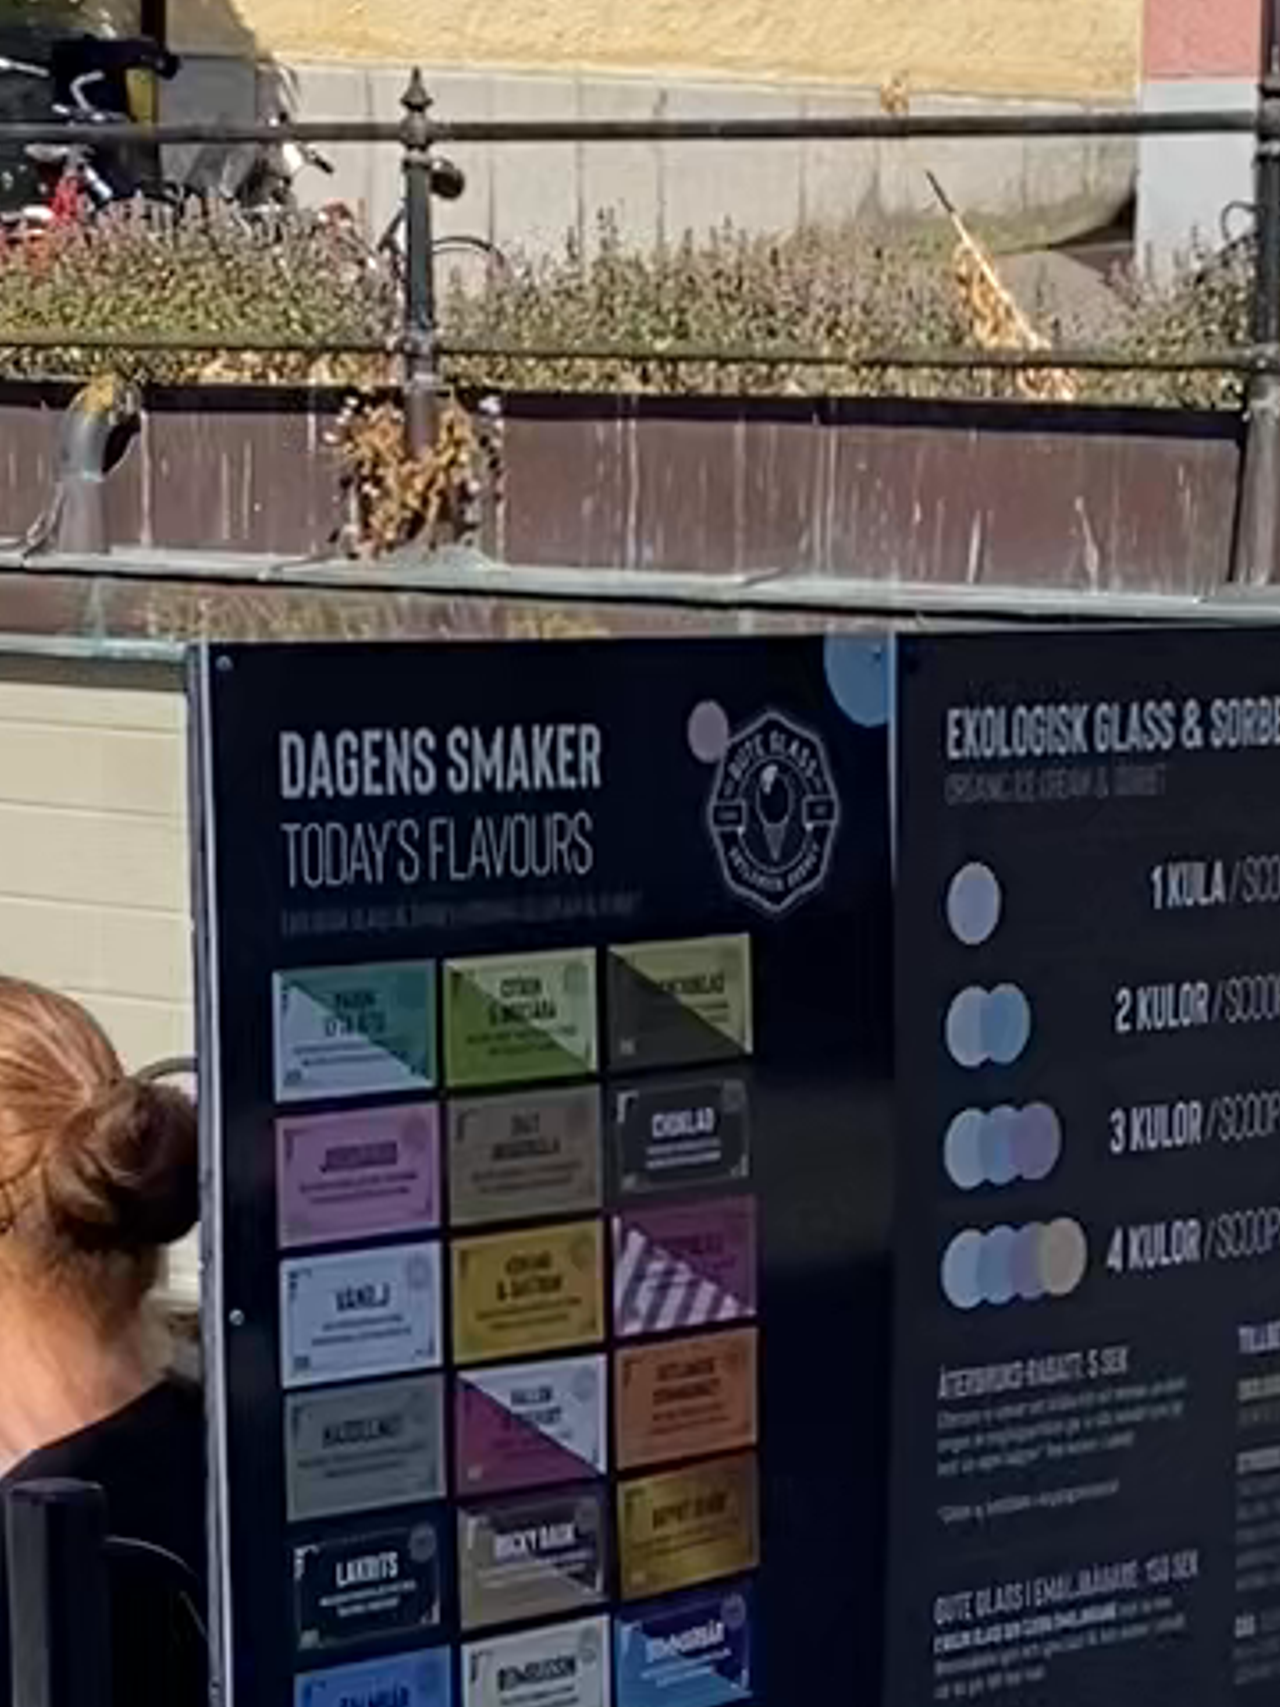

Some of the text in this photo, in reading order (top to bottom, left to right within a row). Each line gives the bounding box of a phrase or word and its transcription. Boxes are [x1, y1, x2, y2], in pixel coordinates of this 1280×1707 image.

[945, 702, 1090, 761] EKOLOGISK
[1093, 698, 1176, 756] GLASS
[1180, 697, 1204, 749] &
[278, 723, 602, 800] DAGENS SMAKER
[280, 810, 594, 889] TODAY'S FLAVOURS
[1151, 864, 1163, 910] 1
[1166, 859, 1227, 908] KULA
[1114, 987, 1133, 1034] 2
[1135, 981, 1211, 1031] KULOR
[1109, 1108, 1128, 1155] 3
[1129, 1100, 1204, 1153] KULOR
[1106, 1227, 1125, 1273] 4
[1127, 1219, 1203, 1271] KULOR
[334, 1550, 400, 1589] LAKRITS
